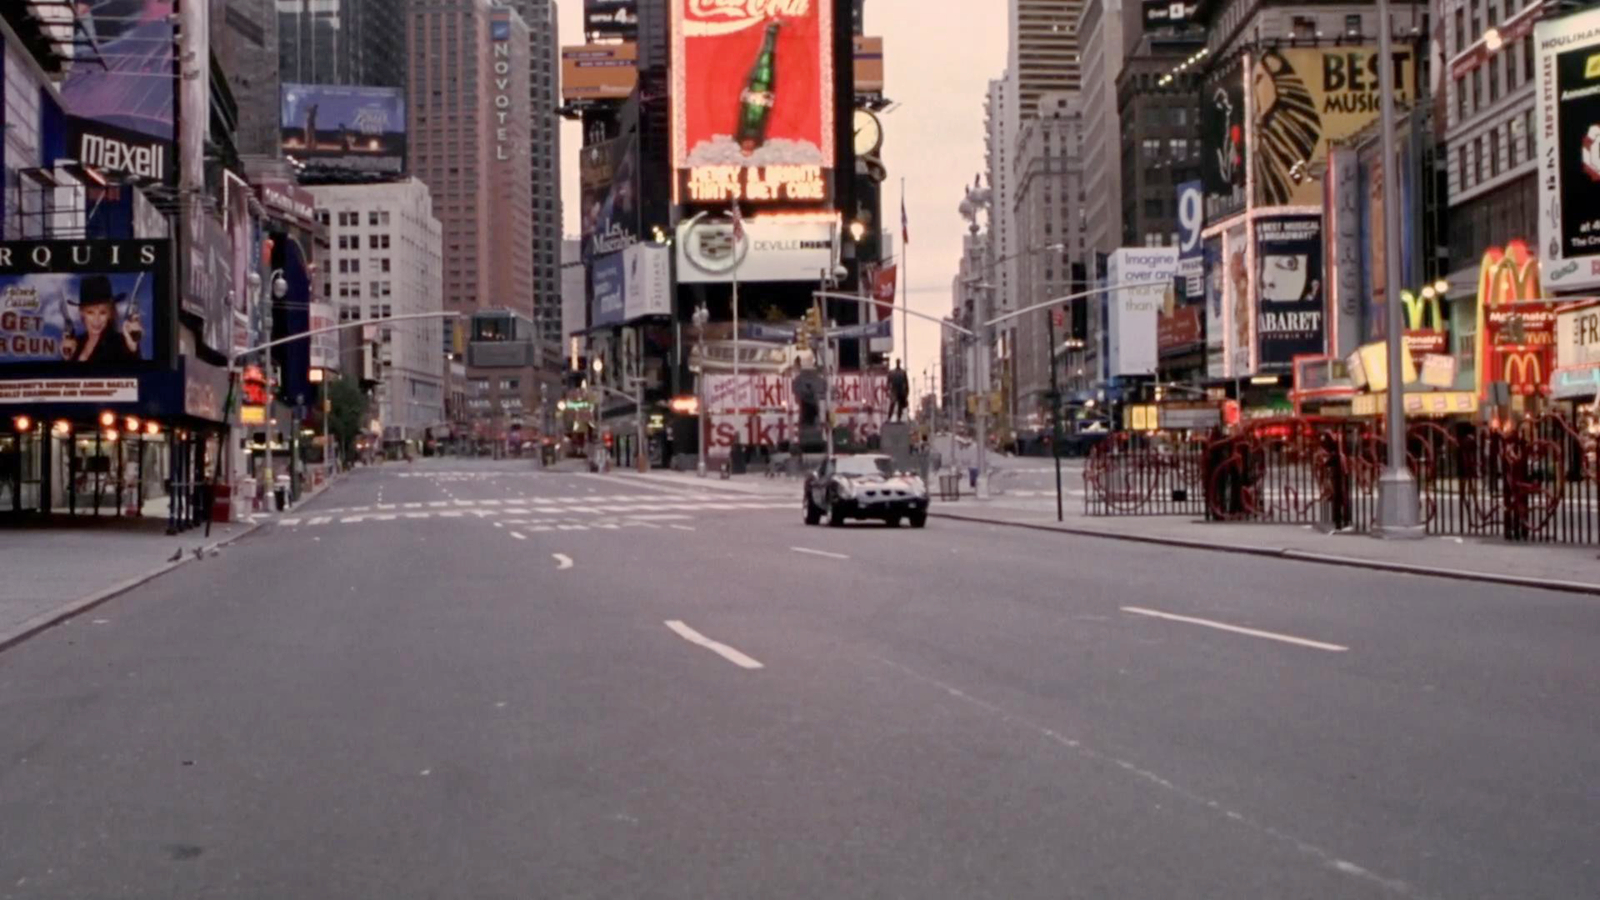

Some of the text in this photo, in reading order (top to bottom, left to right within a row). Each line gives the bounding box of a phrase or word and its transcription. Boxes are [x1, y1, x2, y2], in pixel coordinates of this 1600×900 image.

[494, 43, 509, 160] NOVOTEL
[81, 133, 163, 180] maxell
[1179, 187, 1202, 252] 9
[754, 240, 798, 250] DEVILLE
[1125, 252, 1174, 269] Imagine
[1125, 270, 1153, 281] over
[1, 311, 42, 332] GET
[12, 334, 55, 353] GUN
